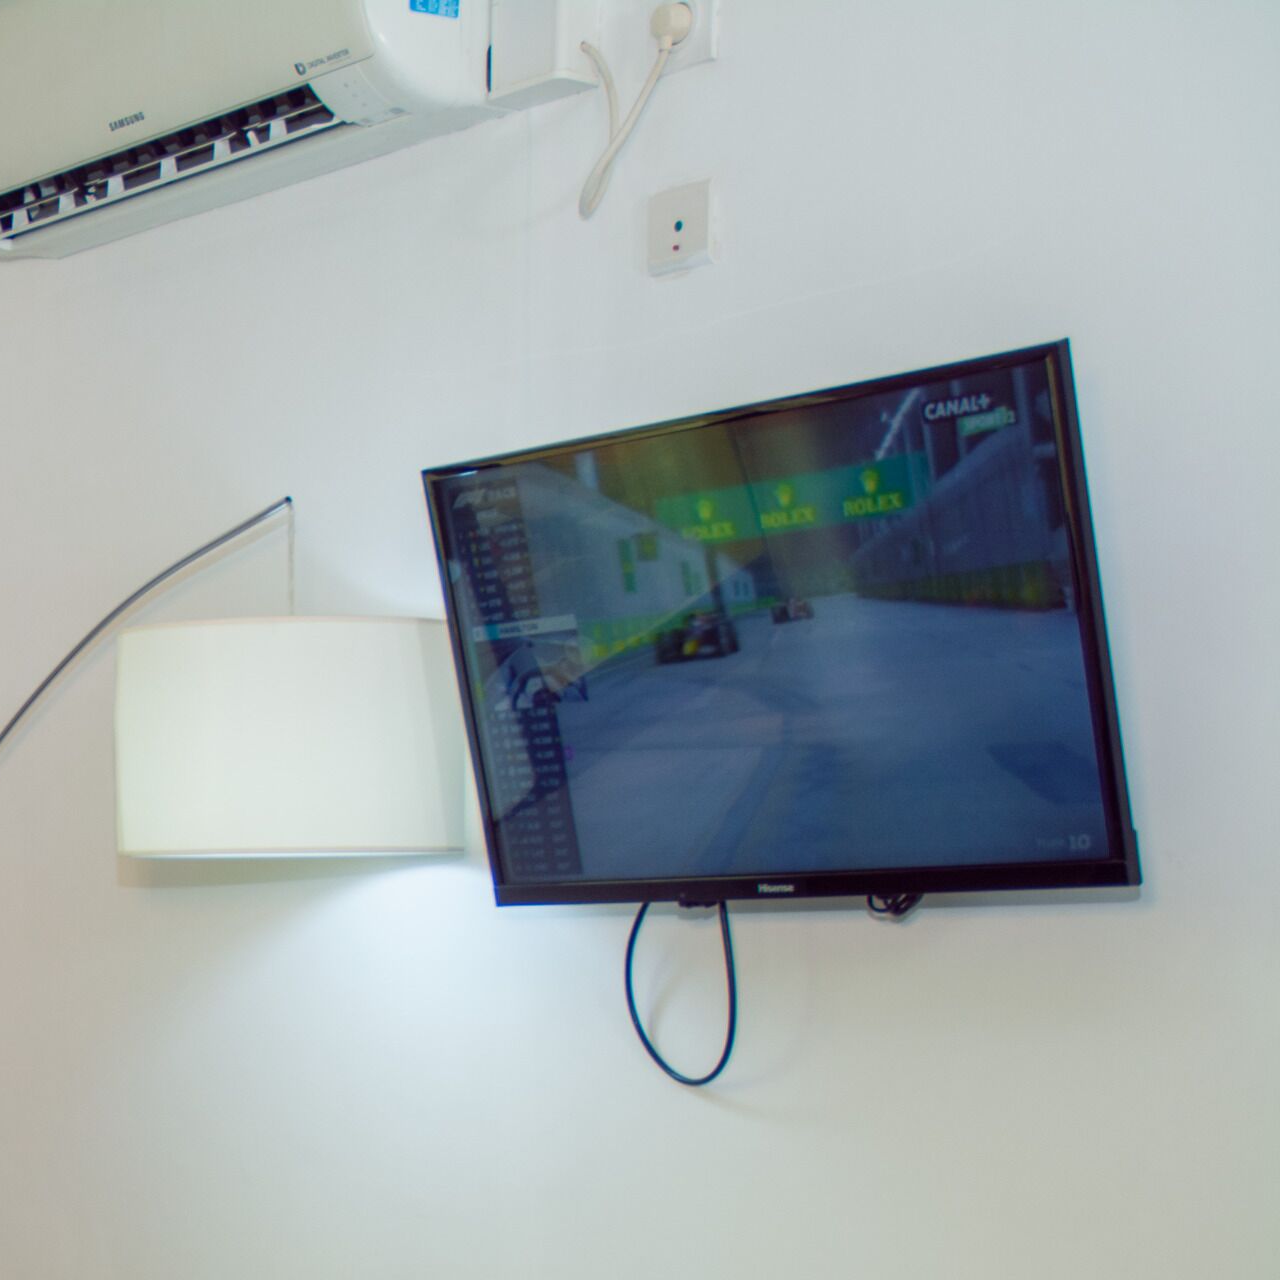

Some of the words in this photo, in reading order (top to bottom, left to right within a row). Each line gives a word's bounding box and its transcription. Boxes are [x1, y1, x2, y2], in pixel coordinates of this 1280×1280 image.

[109, 111, 144, 131] SAMSUNG
[924, 393, 990, 420] CANAL+
[843, 492, 902, 518] ROLEX
[760, 506, 816, 529] ROLEX
[757, 883, 795, 893] Hisense
